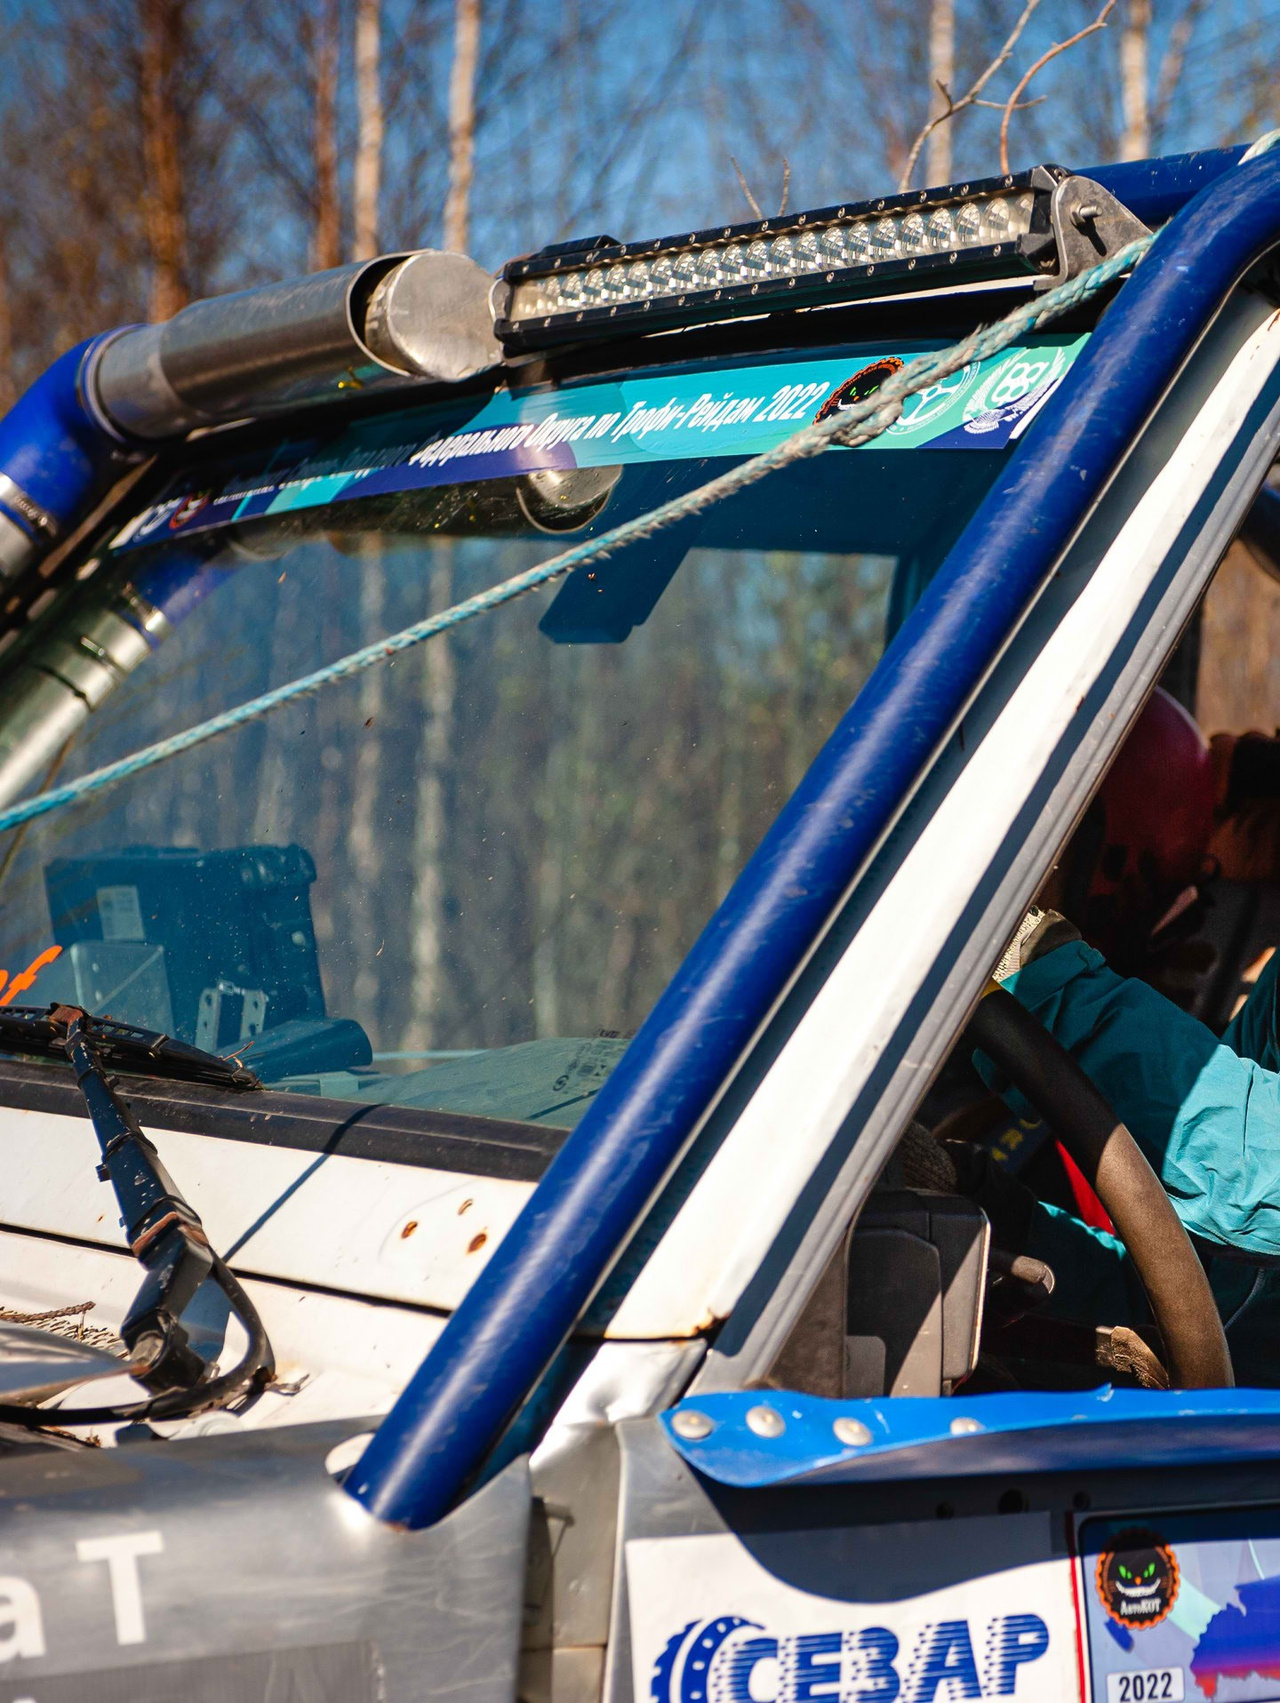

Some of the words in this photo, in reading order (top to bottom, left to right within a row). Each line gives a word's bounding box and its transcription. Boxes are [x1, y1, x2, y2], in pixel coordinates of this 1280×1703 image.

[588, 412, 620, 439] по
[757, 381, 830, 422] 2022
[713, 1614, 1050, 1703] СЕЗАР
[1119, 1672, 1173, 1703] 2022
